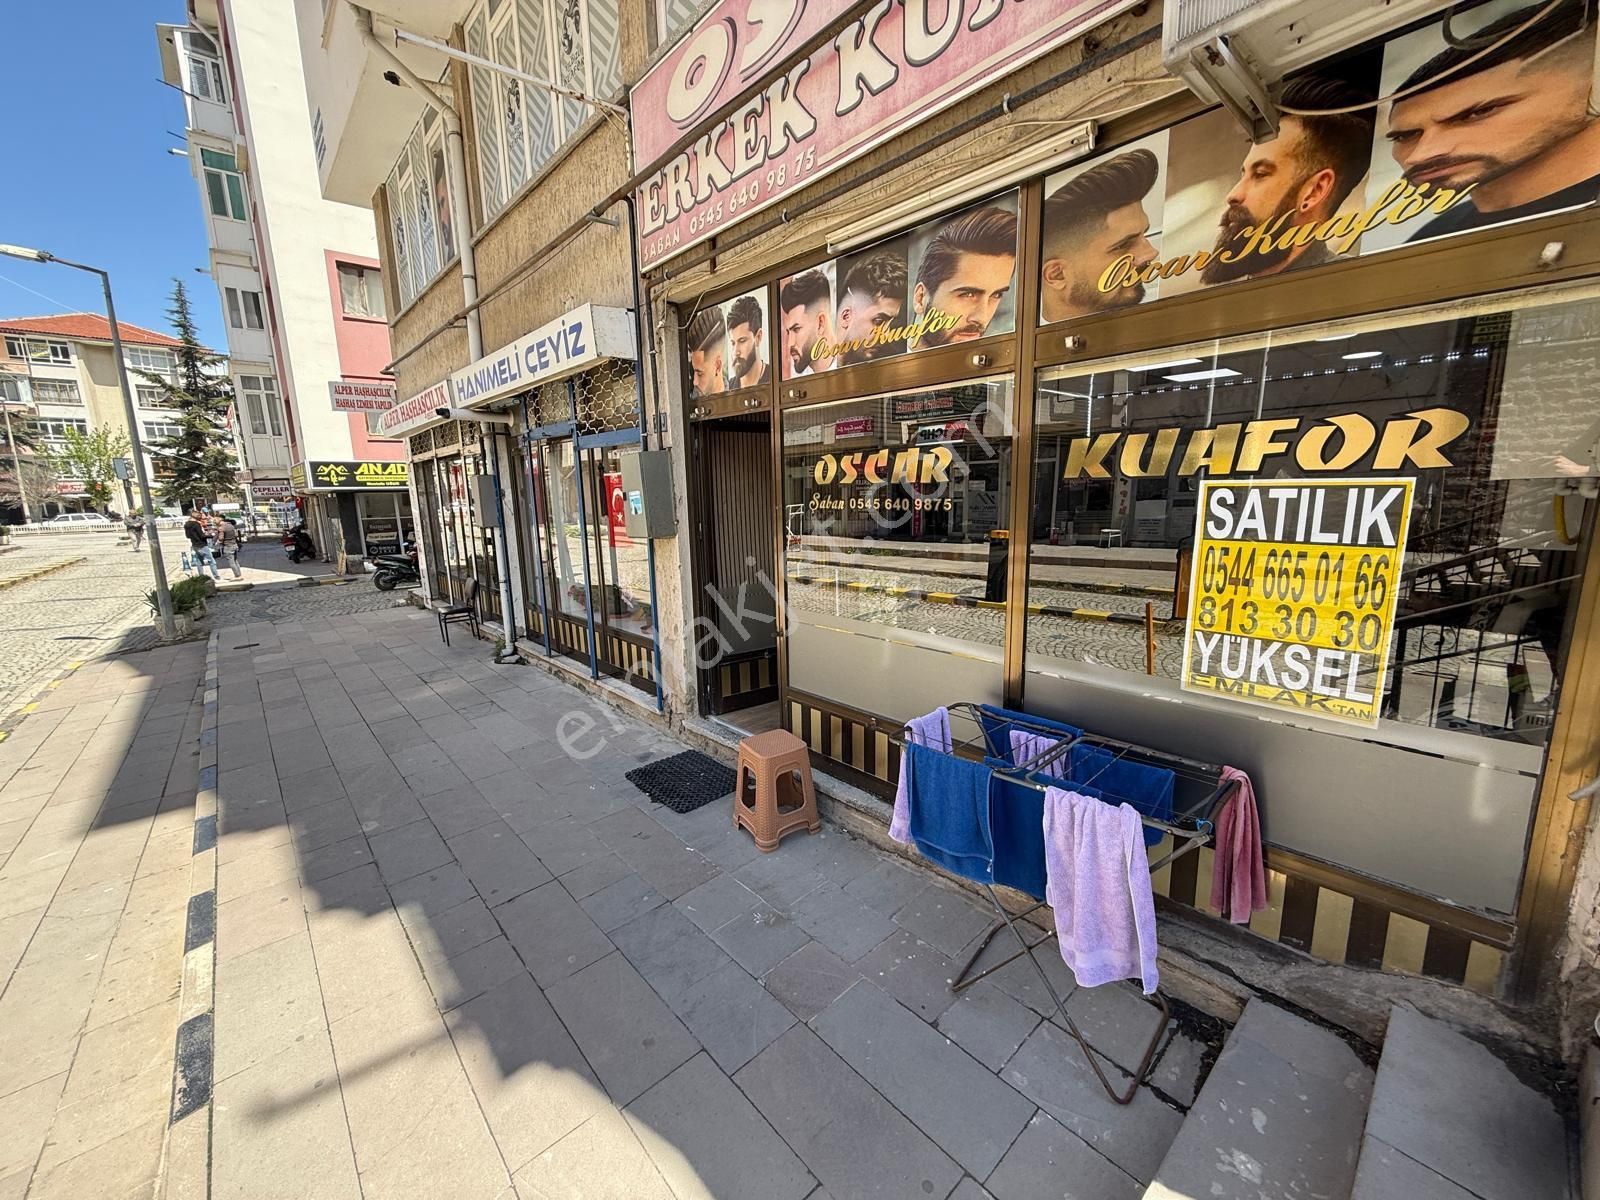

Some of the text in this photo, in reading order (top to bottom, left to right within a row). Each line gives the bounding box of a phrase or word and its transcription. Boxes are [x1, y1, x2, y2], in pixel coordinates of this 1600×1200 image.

[639, 57, 818, 239] ERKEK
[689, 199, 723, 236] 0545
[729, 179, 759, 213] 640
[766, 163, 787, 192] 98
[793, 144, 816, 177] 75
[1097, 179, 1480, 293] Oscar Kuaför
[456, 319, 586, 402] HANIMELİ ÇEYİZ
[810, 307, 962, 361] Oscar Kuaför
[334, 385, 353, 395] ALPER
[383, 408, 400, 430] ALPER
[814, 446, 953, 485] OSCAR
[1063, 407, 1471, 479] KUAFOR
[252, 486, 290, 495] ÇEPELLER
[809, 492, 845, 514] Şaban
[849, 498, 881, 510] 0545
[884, 498, 910, 511] 640
[914, 498, 953, 511] 9875
[1206, 487, 1403, 546] SATILIK
[1202, 545, 1390, 611] 0544 665 01 66
[1198, 595, 1382, 651] 813 30 30
[1194, 631, 1374, 704] YÜKSEL
